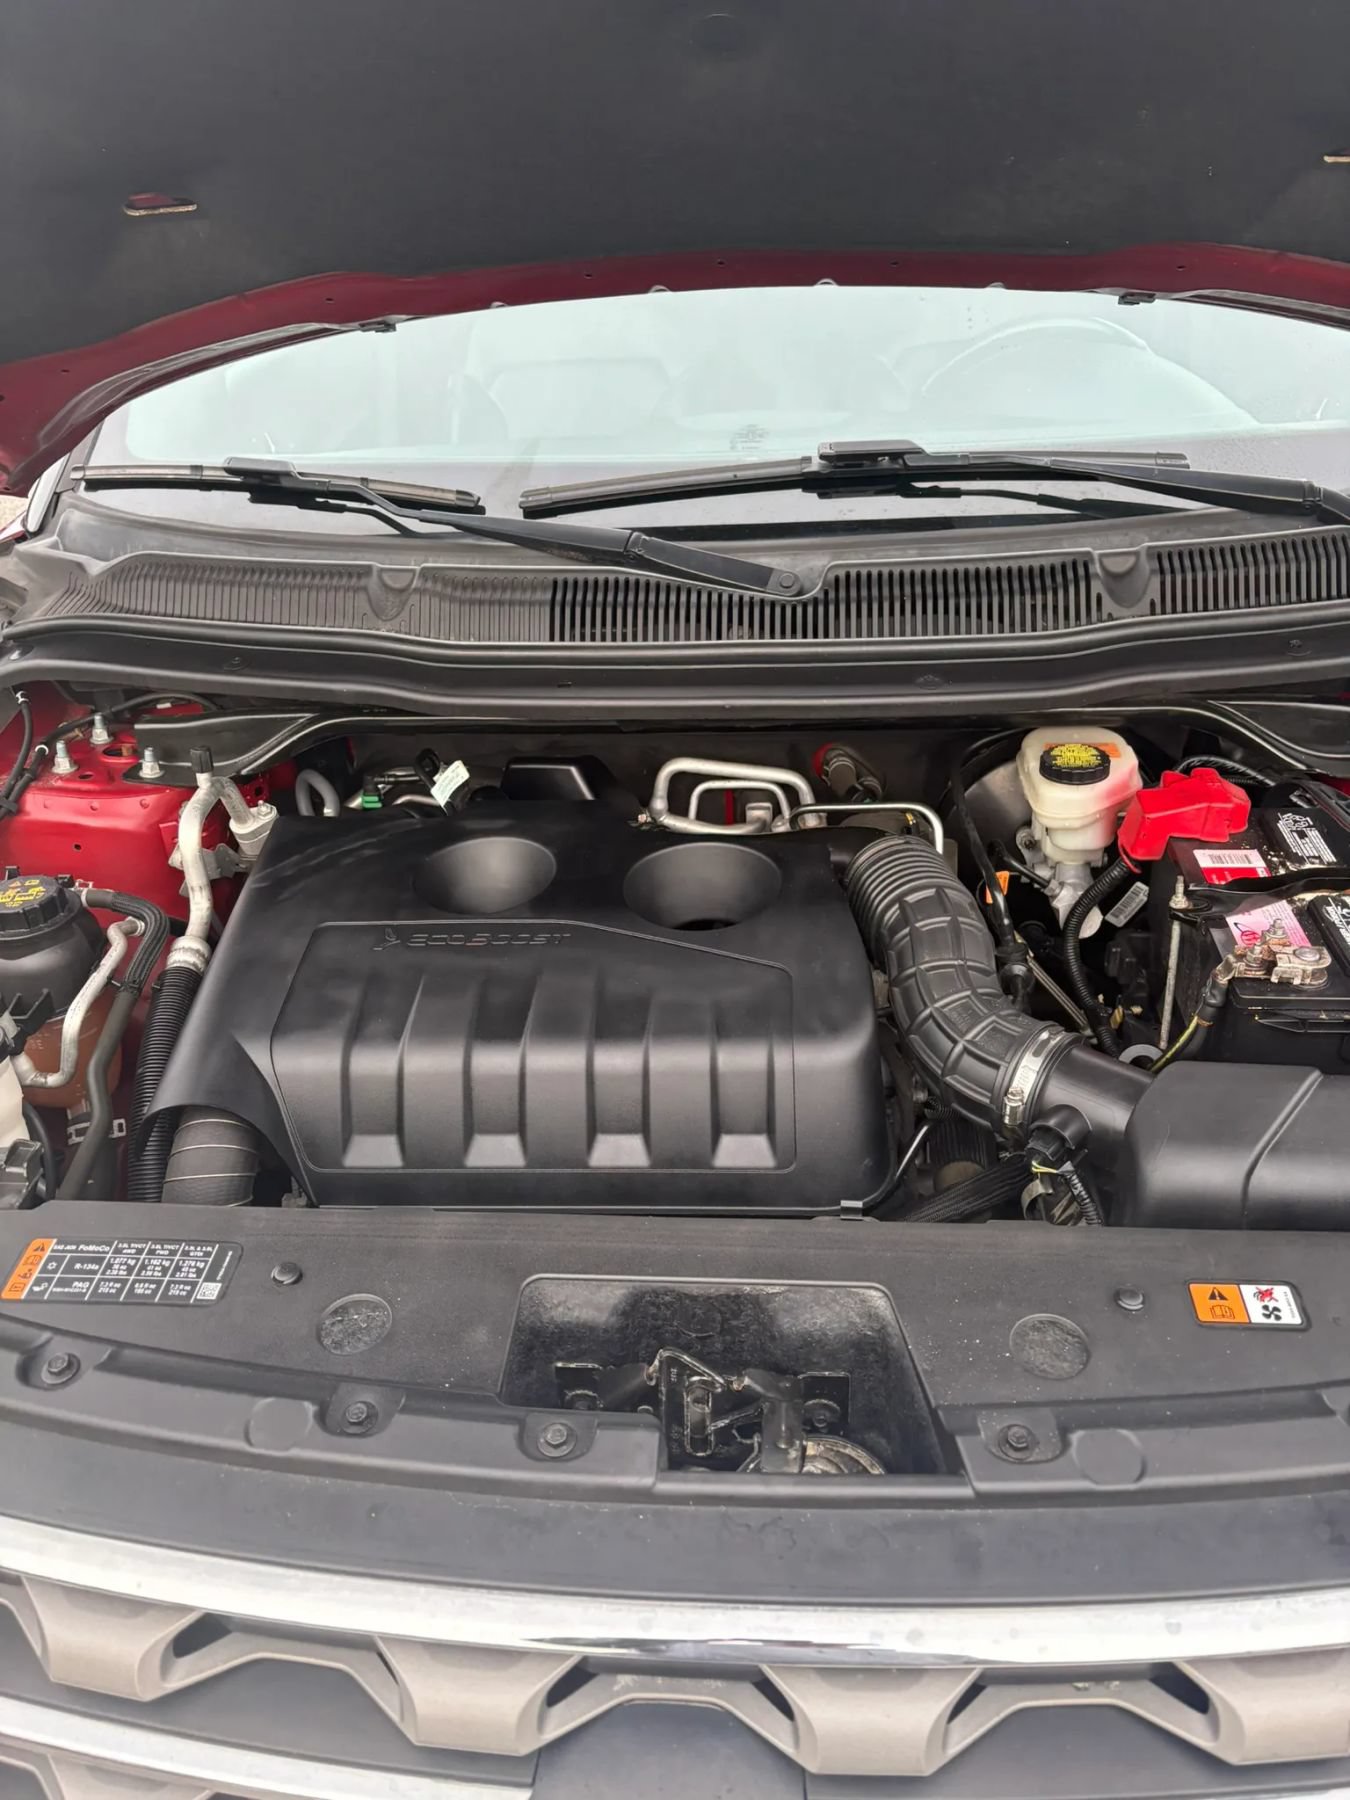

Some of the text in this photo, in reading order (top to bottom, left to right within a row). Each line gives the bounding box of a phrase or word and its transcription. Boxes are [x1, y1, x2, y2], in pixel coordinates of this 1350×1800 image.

[78, 1244, 110, 1252] FoMoCo
[127, 1258, 137, 1266] kg
[161, 1259, 171, 1267] kg
[196, 1261, 206, 1269] kg
[71, 1281, 90, 1289] PAG
